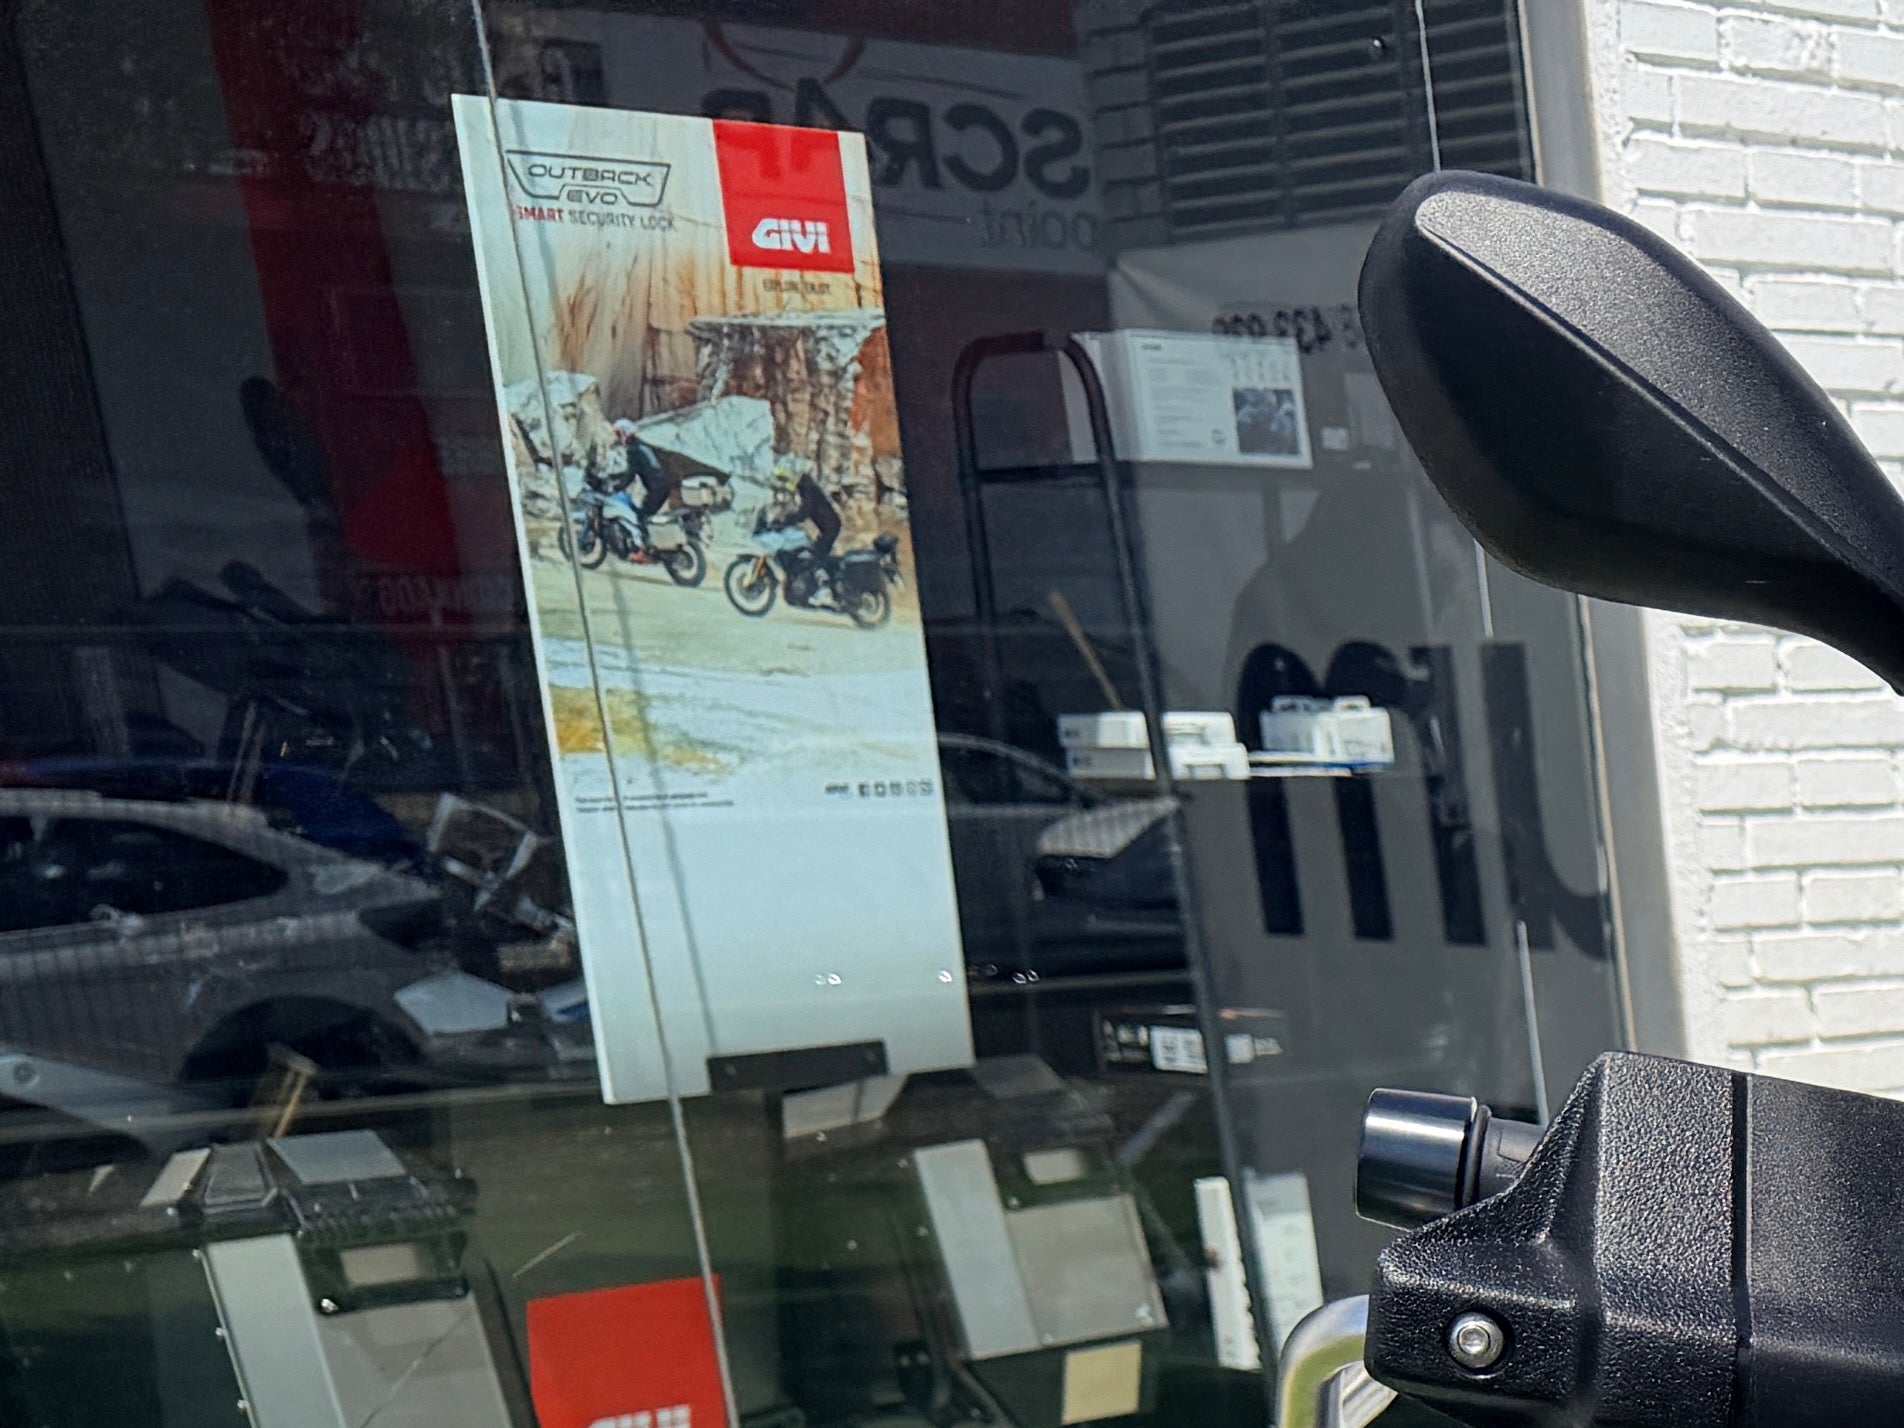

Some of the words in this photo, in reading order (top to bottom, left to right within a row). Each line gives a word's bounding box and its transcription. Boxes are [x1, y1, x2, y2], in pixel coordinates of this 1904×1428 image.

[527, 163, 655, 189] OUTBACK
[566, 189, 619, 207] EVO
[568, 208, 637, 231] SECURITY
[750, 216, 831, 254] GIVI
